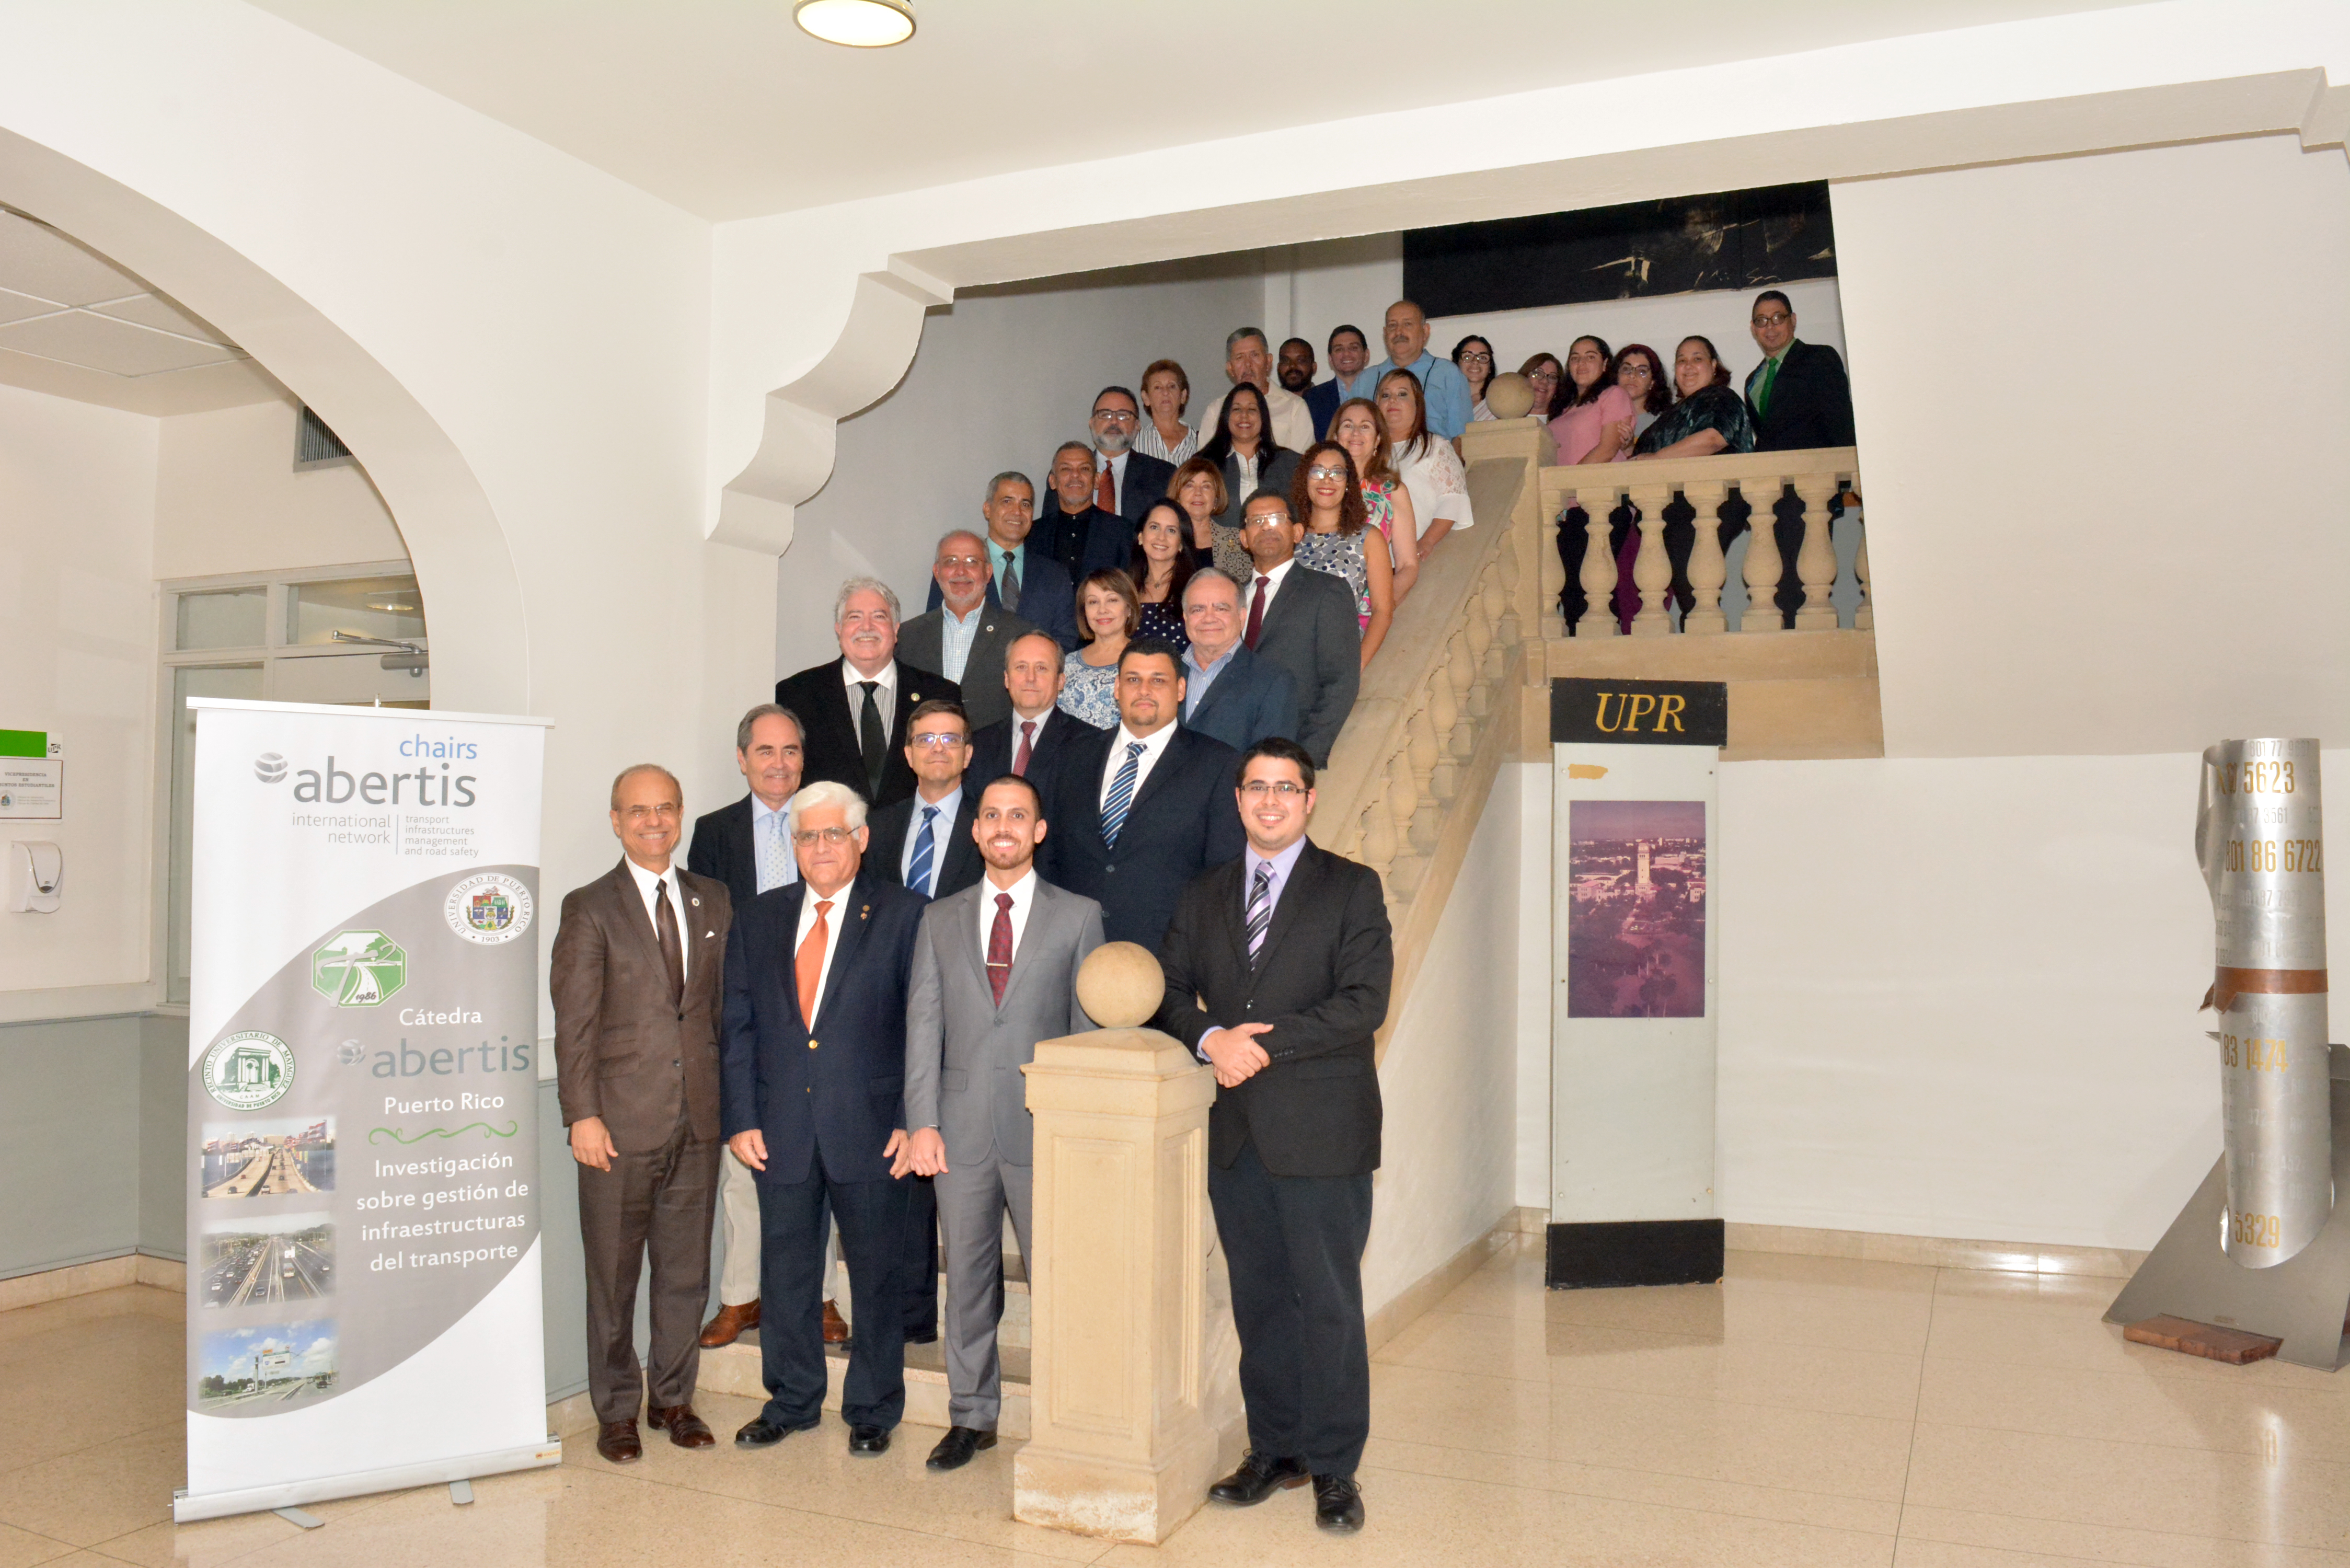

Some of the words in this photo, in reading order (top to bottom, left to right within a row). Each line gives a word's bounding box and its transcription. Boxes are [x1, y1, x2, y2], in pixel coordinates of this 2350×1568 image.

[1596, 693, 1686, 732] UPR
[48, 744, 61, 753] UPR
[399, 734, 478, 759] chairs
[294, 756, 477, 807] abertis
[2244, 761, 2295, 794] 5623
[293, 812, 390, 828] international
[406, 815, 450, 825] transport
[406, 825, 474, 835] infrastructures
[328, 831, 390, 844] network
[405, 837, 467, 847] management
[405, 847, 422, 855] and
[426, 847, 446, 855] road
[450, 847, 479, 858] safety
[2226, 840, 2244, 872] 801
[2251, 839, 2276, 872] 86
[2284, 839, 2321, 872] 6722
[448, 877, 483, 934] UNIVERSIDAD
[503, 878, 530, 908] PUERTO
[515, 911, 530, 932] RICO
[356, 991, 376, 1002] 1986
[399, 1007, 482, 1025] Cátedra
[210, 1032, 269, 1057] UNIVERSITARIO
[272, 1039, 282, 1047] DE
[2224, 1034, 2238, 1067] 83
[2244, 1038, 2288, 1073] 1474
[372, 1035, 529, 1078] abertis
[205, 1061, 216, 1093] RECINTO
[282, 1050, 293, 1089] MAYAGUEZ
[216, 1094, 245, 1108] UNIVERSIDAD
[254, 1099, 271, 1107] PUERTO
[271, 1091, 281, 1100] RICO
[385, 1097, 454, 1114] Puerto
[461, 1093, 504, 1110] Rico
[375, 1152, 513, 1177] Investigación
[356, 1191, 416, 1210] sobre
[422, 1183, 498, 1210] gestión
[505, 1180, 528, 1197] de
[362, 1214, 525, 1241] infraestructuras
[370, 1251, 402, 1272] del
[409, 1244, 518, 1267] transporte
